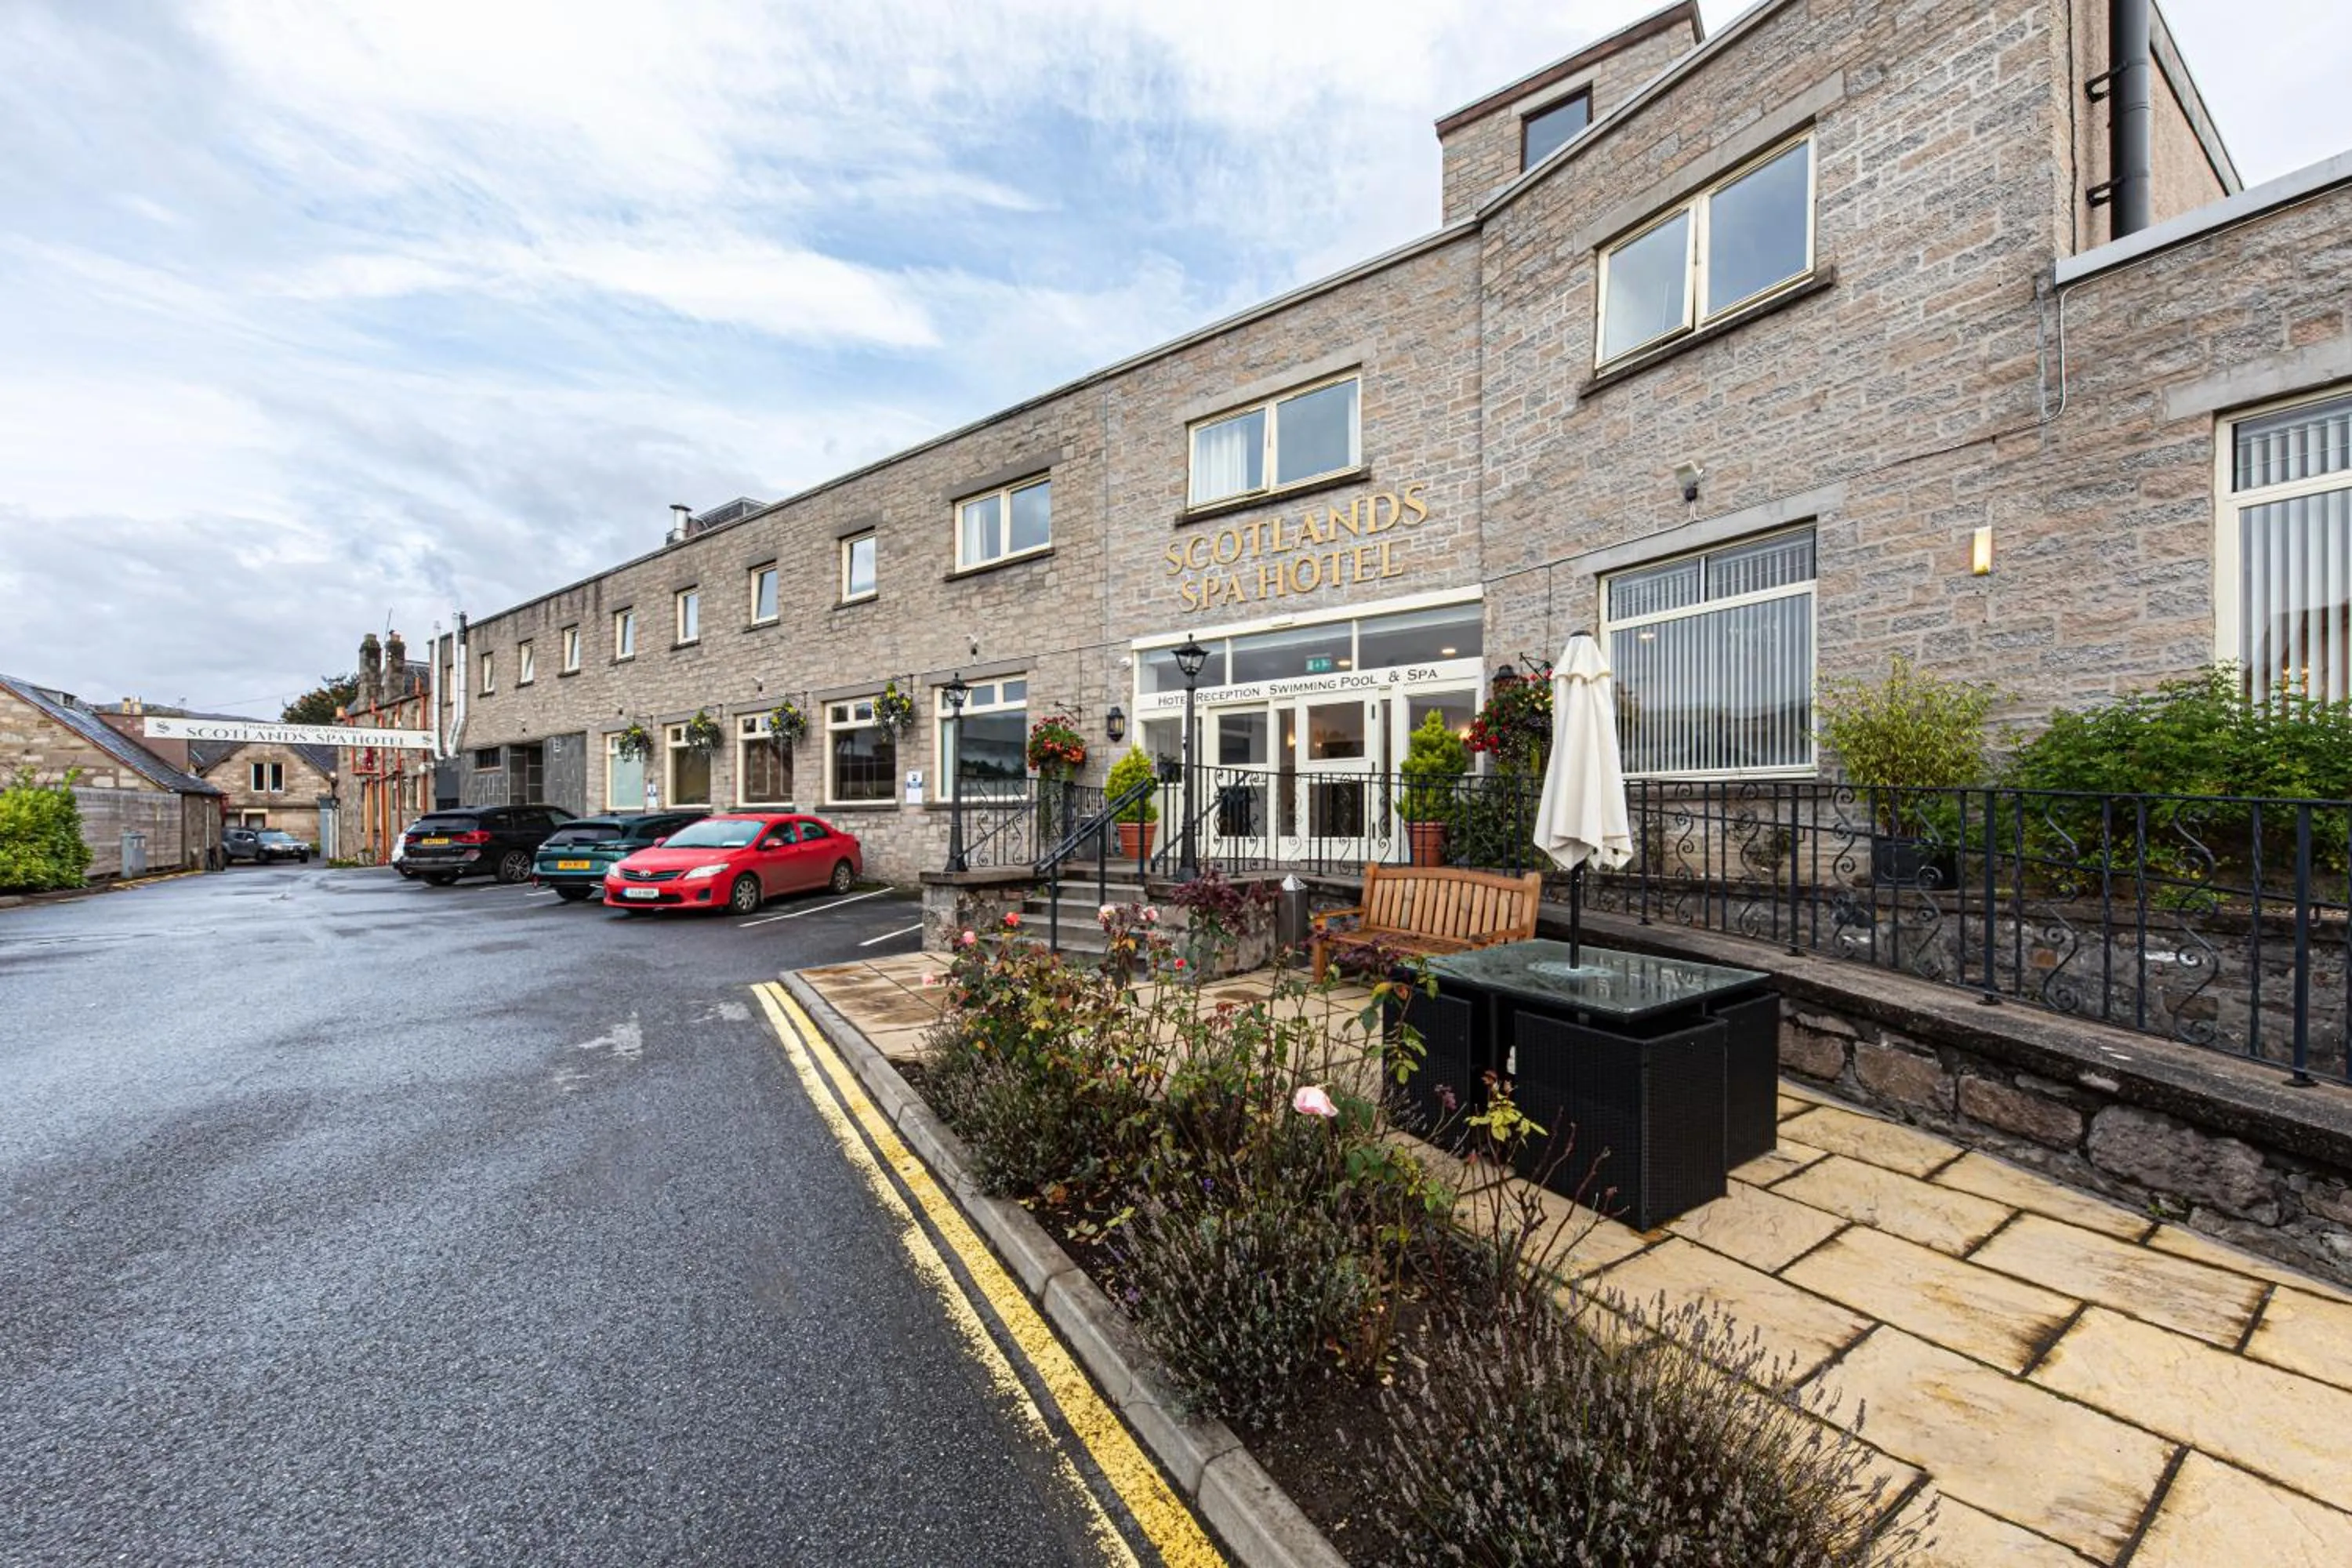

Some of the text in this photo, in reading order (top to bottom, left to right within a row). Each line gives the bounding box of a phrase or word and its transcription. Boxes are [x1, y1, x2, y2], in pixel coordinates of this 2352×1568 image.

[1165, 481, 1428, 575] SCOTLANDS
[1178, 540, 1403, 615] SPA HOTEL
[1158, 669, 1439, 706] HOTE RECEPTION SWIMMING POOL & SPA
[186, 727, 404, 746] SCOTLANDS SPA HOTEL
